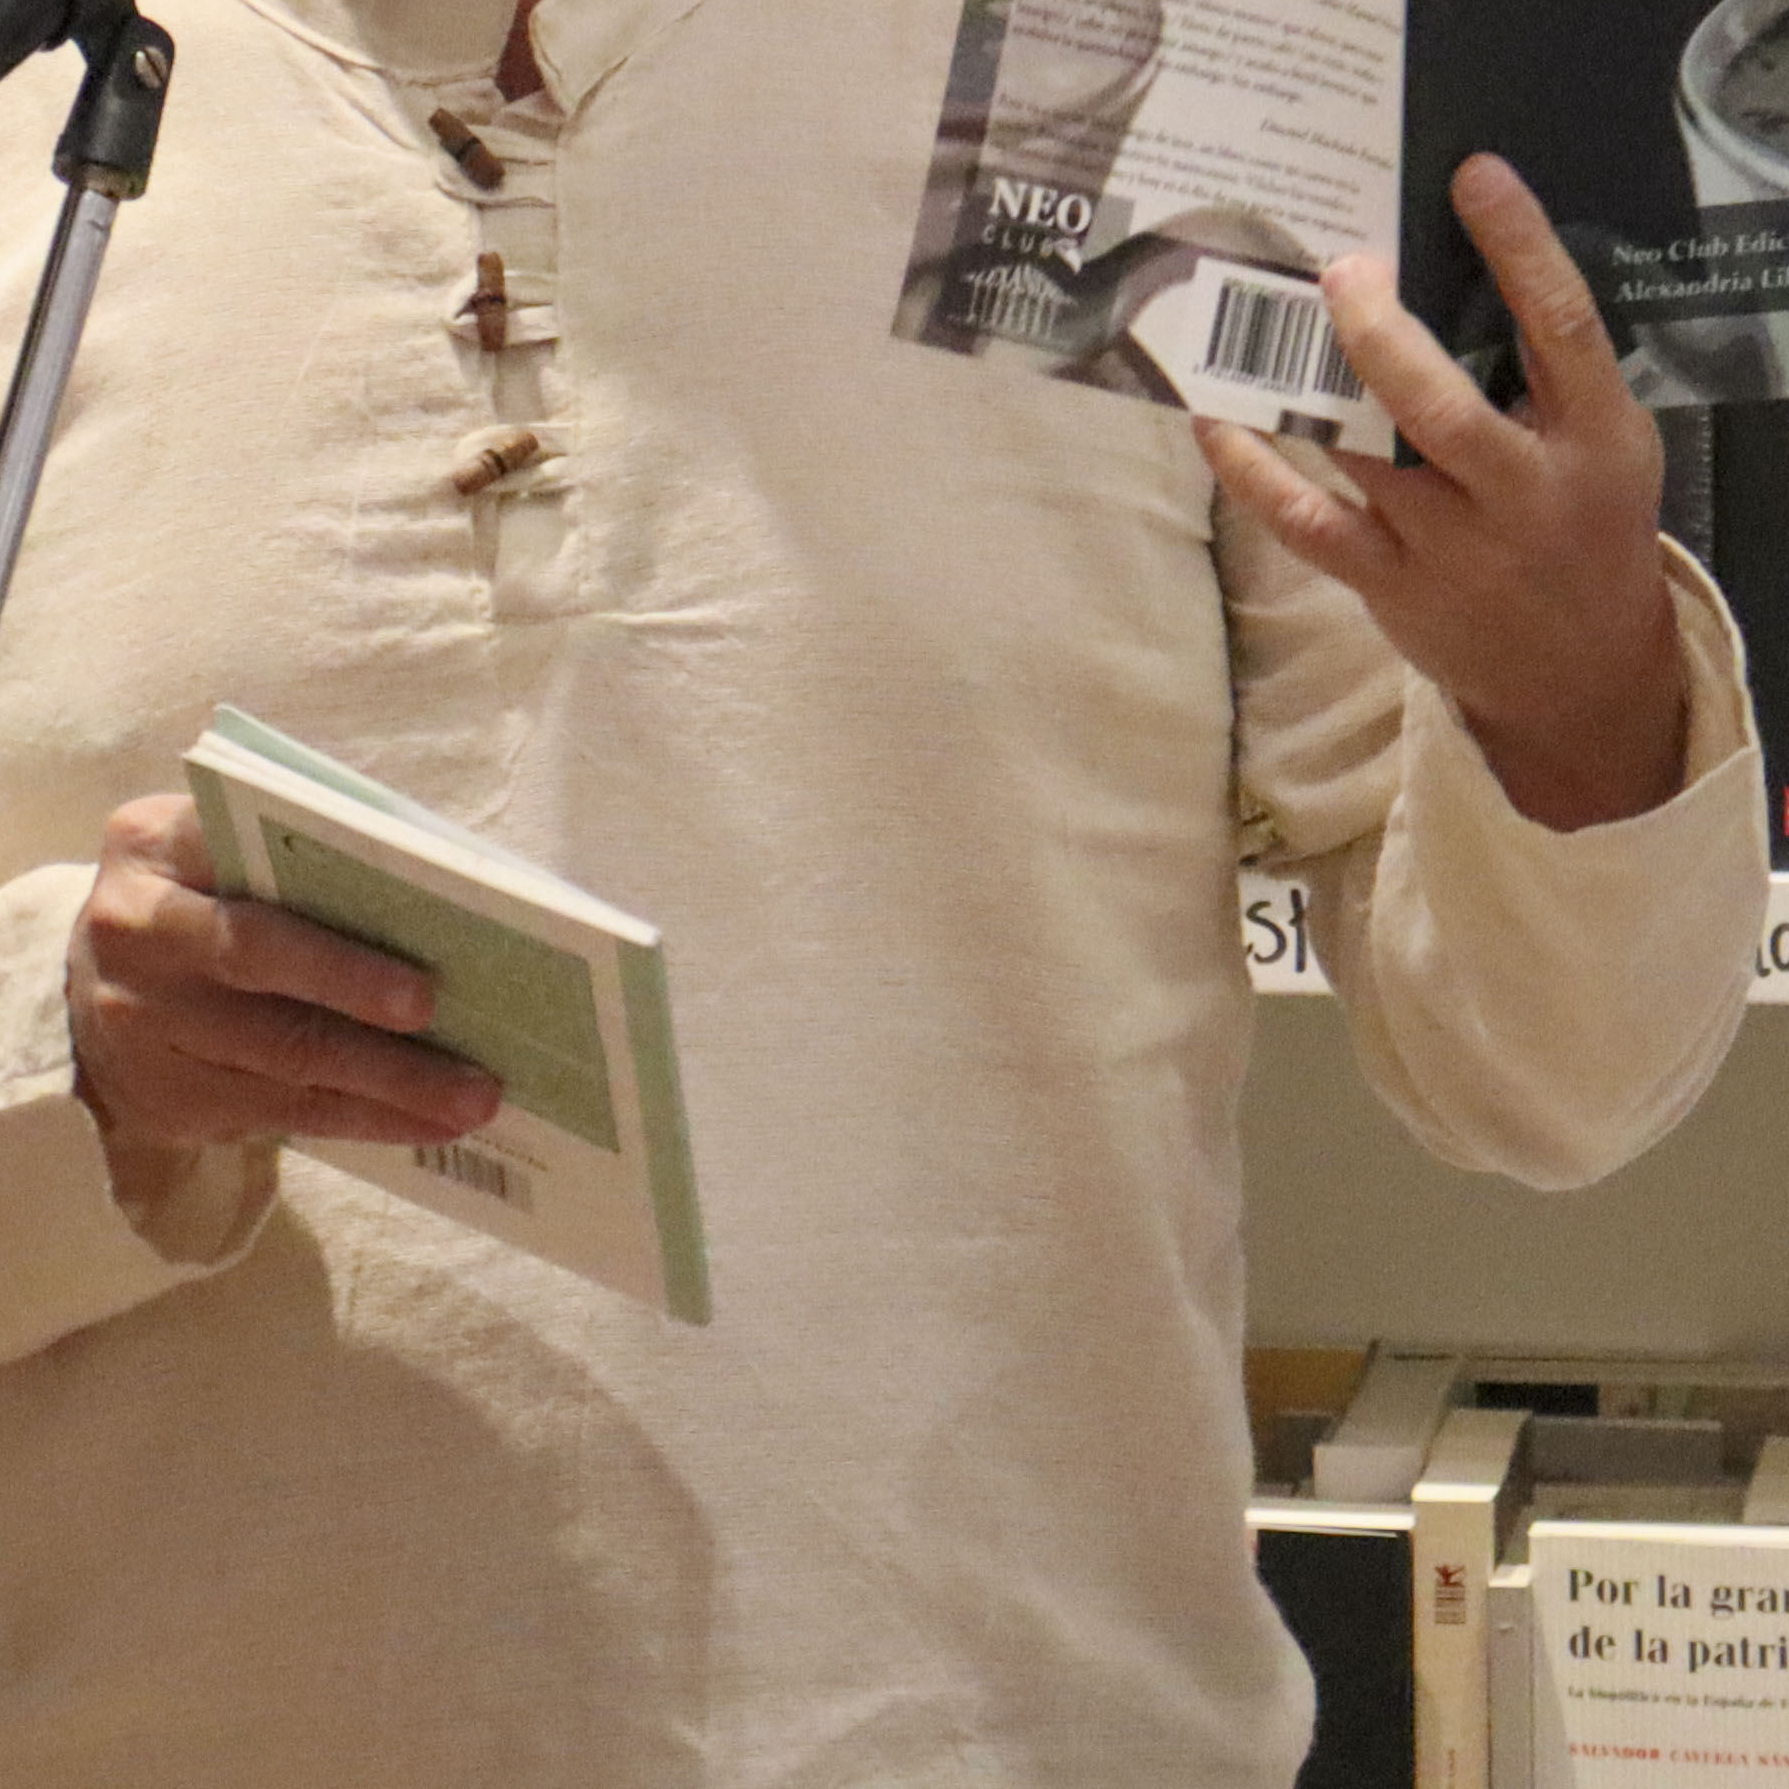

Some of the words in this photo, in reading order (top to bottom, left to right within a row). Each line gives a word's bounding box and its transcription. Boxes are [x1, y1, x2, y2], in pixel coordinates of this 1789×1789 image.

[989, 176, 1092, 236] NEO
[1612, 243, 1663, 267] Neo
[1669, 235, 1730, 263] Club
[1614, 272, 1755, 304] Alexandria
[1568, 1568, 1639, 1607] Por
[1657, 1574, 1693, 1609] la
[1568, 1626, 1617, 1661] de
[1634, 1629, 1670, 1665] la
